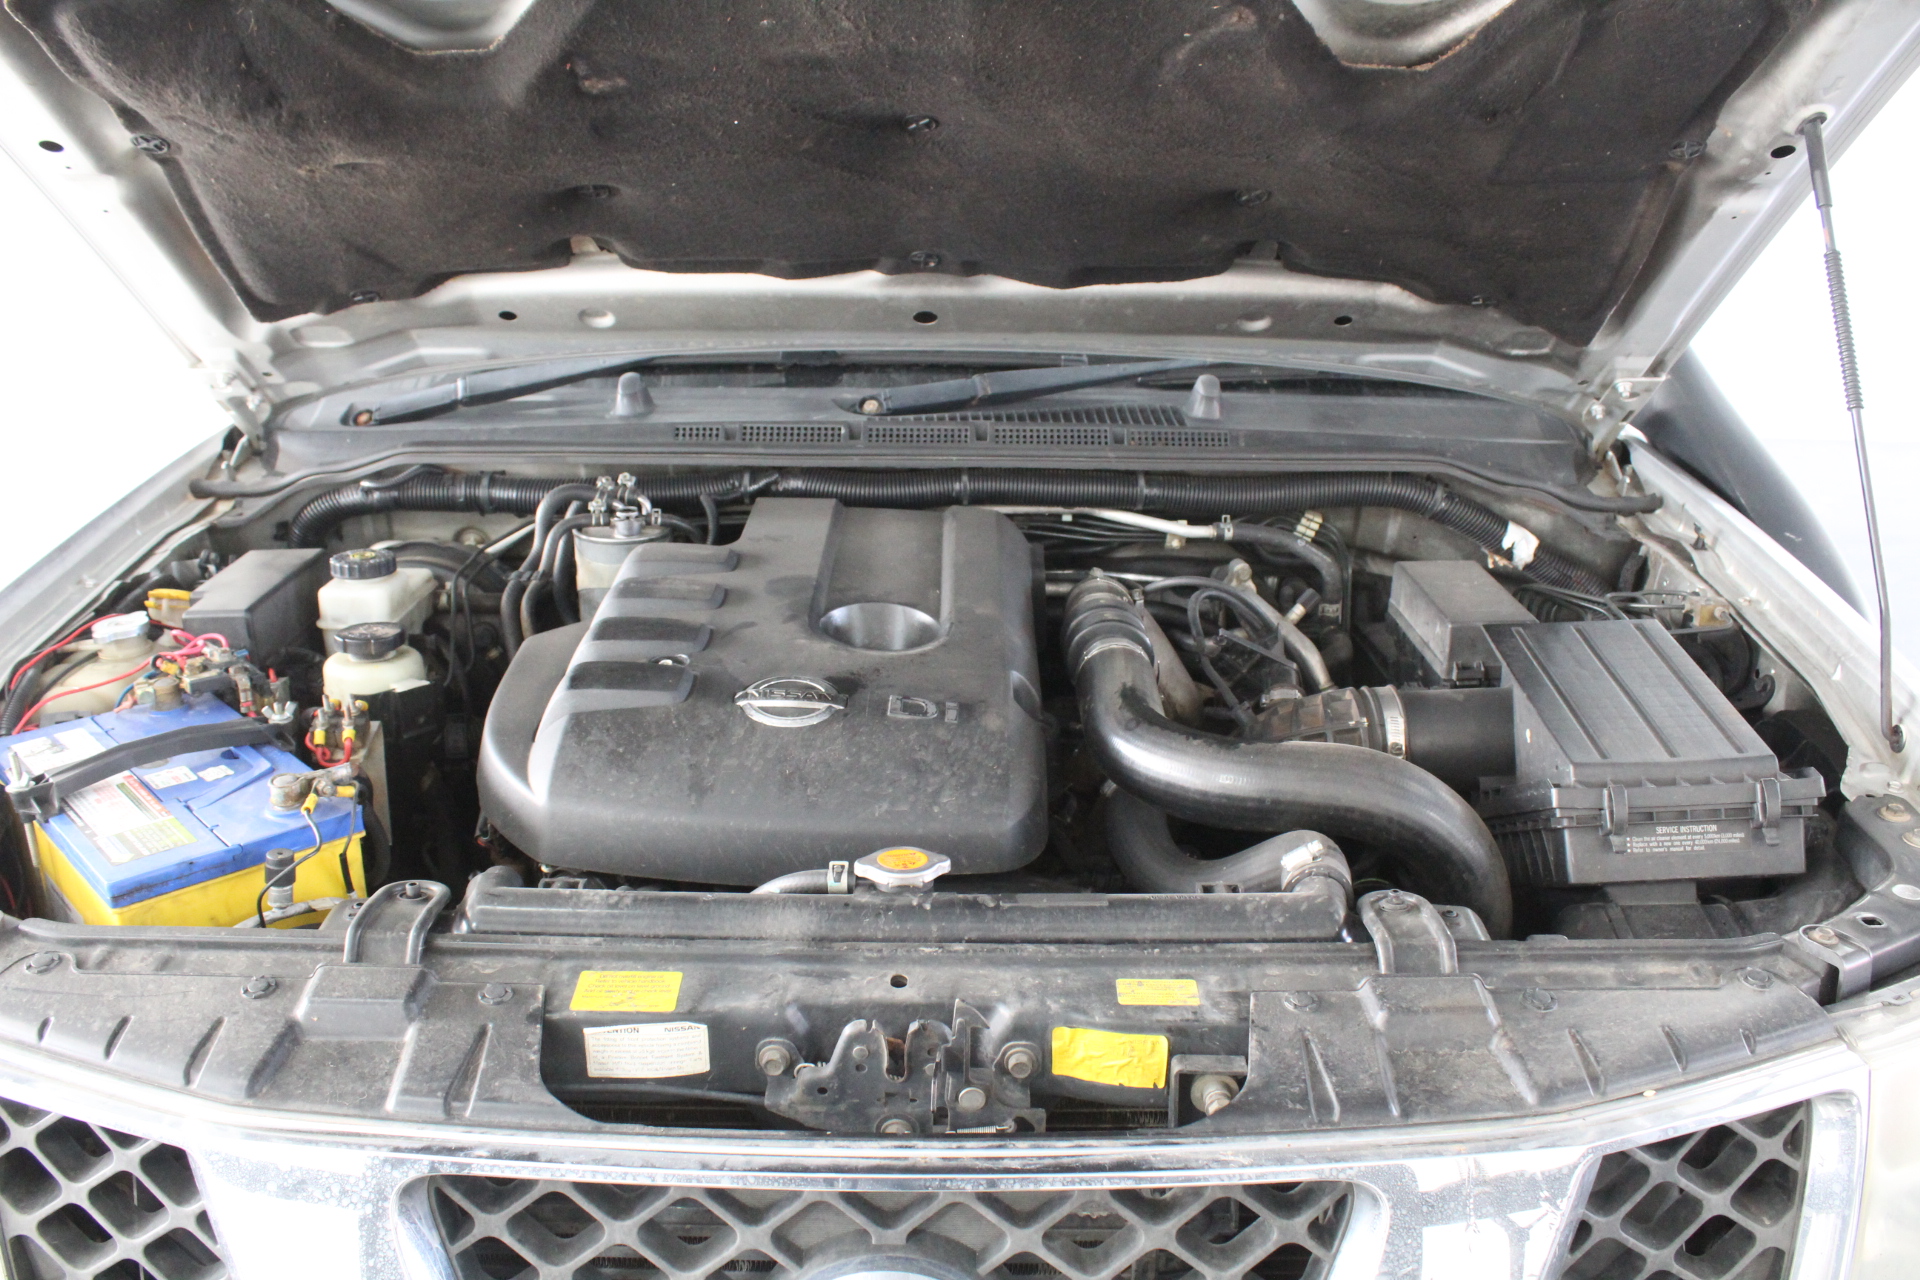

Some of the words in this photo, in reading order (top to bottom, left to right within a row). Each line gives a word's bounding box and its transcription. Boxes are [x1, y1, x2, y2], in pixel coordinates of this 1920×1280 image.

[749, 689, 833, 700] NISSAN
[1656, 826, 1679, 834] SERVICE
[1680, 824, 1718, 833] INSTRUCTION
